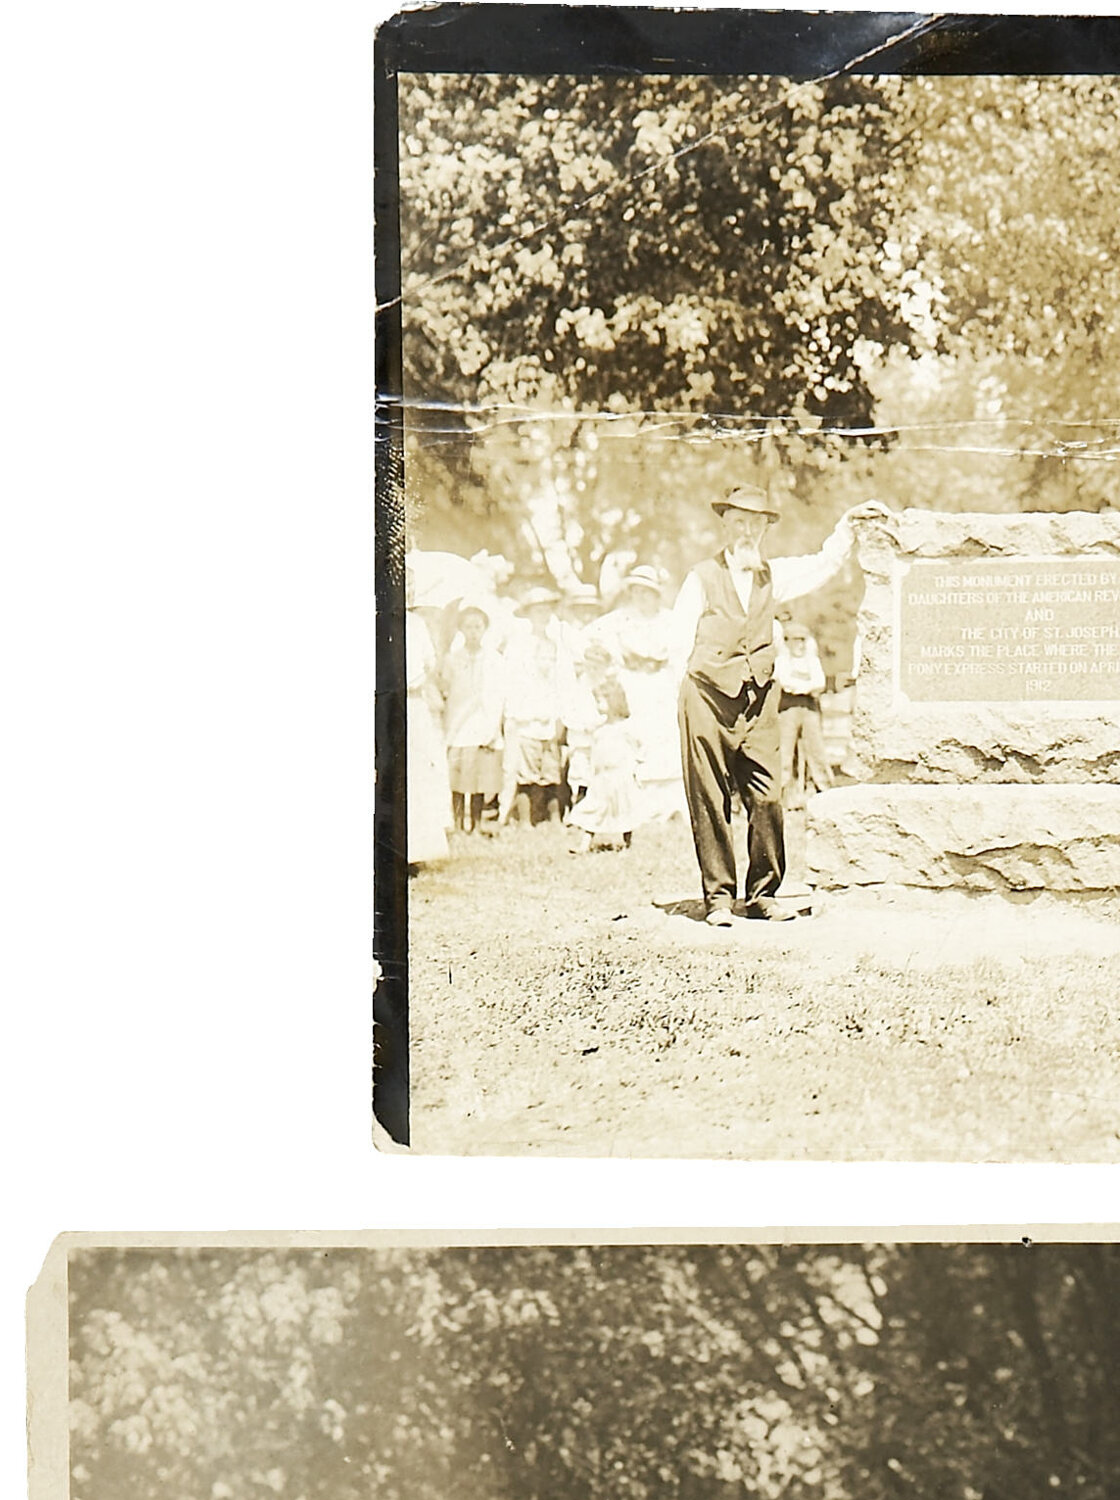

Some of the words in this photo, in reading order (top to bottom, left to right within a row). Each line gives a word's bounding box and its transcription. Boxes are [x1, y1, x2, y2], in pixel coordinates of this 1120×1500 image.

[935, 575, 961, 588] THIS
[963, 574, 1033, 588] MONUMENT
[1036, 573, 1097, 586] ERECTED
[1100, 572, 1117, 585] BY
[908, 592, 984, 605] DAUGHTERS
[987, 592, 1001, 604] OF
[1005, 591, 1030, 604] THE
[1032, 590, 1092, 603] AMERICAN
[1025, 608, 1054, 622] AND
[960, 627, 986, 640] THE
[990, 627, 1019, 640] CITY
[1022, 627, 1040, 640] OF
[1043, 626, 1063, 639] ST.
[920, 645, 965, 658] MARKS
[969, 644, 993, 657] THE
[996, 644, 1041, 657] PLACE
[1043, 643, 1088, 657] WHERE
[1093, 643, 1120, 656] THE
[908, 662, 943, 675] PONY
[944, 662, 1006, 675] EXPRESS
[1008, 661, 1066, 674] STARTED
[1069, 661, 1087, 674] ON
[1025, 679, 1051, 692] 1912
